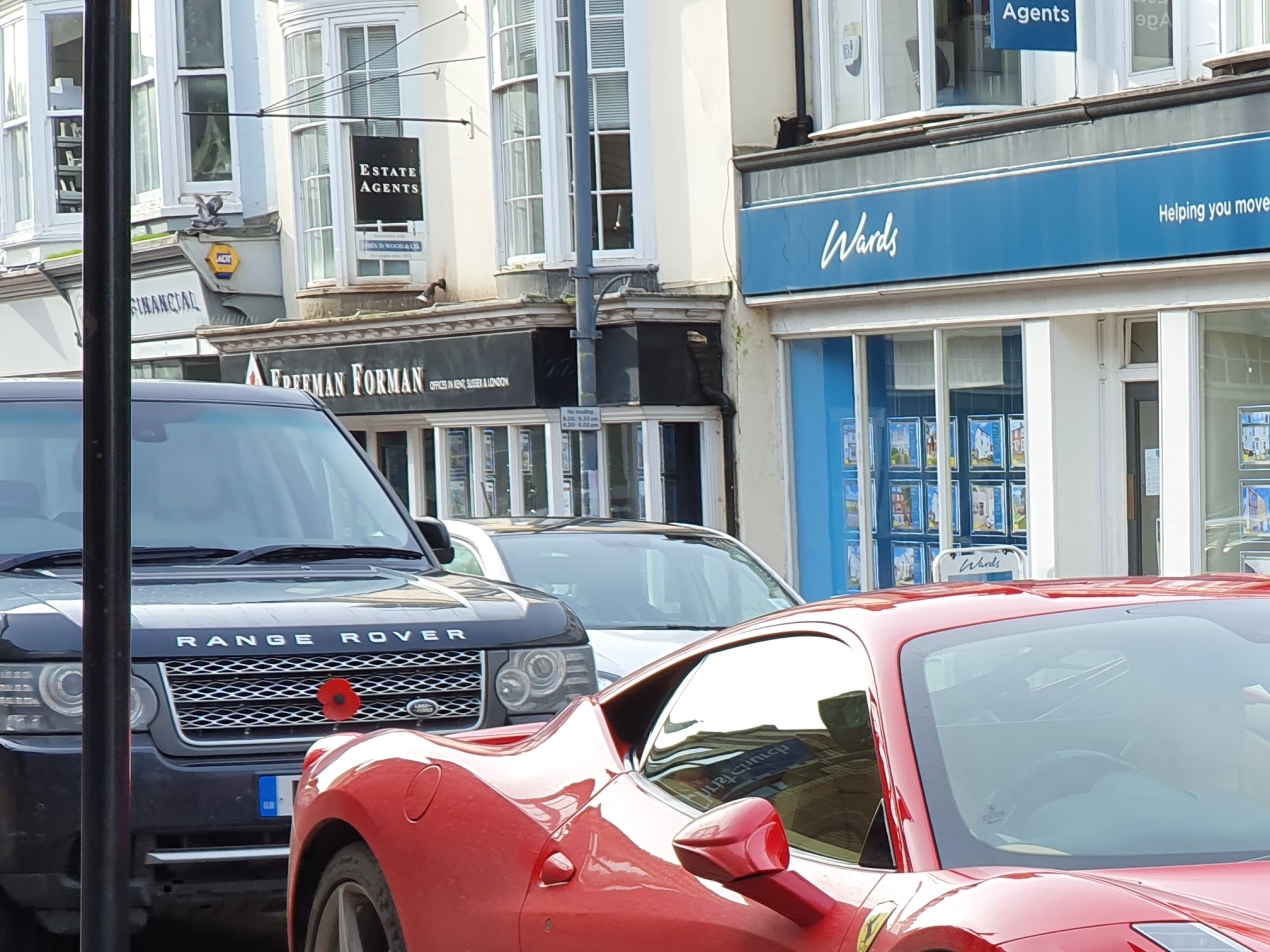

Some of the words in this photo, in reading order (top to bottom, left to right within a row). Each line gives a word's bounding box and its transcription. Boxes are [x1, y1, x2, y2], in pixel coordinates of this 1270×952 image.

[1002, 2, 1069, 24] Agents
[359, 163, 417, 177] ESTATE
[360, 180, 419, 194] AGENTS
[1158, 201, 1206, 224] Helping
[1208, 200, 1232, 221] you
[1235, 194, 1270, 214] move
[821, 211, 899, 270] Wards
[217, 254, 232, 263] ADT
[351, 363, 425, 396] FORMAN
[488, 376, 509, 388] LONDON
[959, 556, 1000, 573] Wards
[176, 634, 314, 648] RANGE
[340, 628, 467, 645] ROVER
[263, 801, 275, 810] GB
